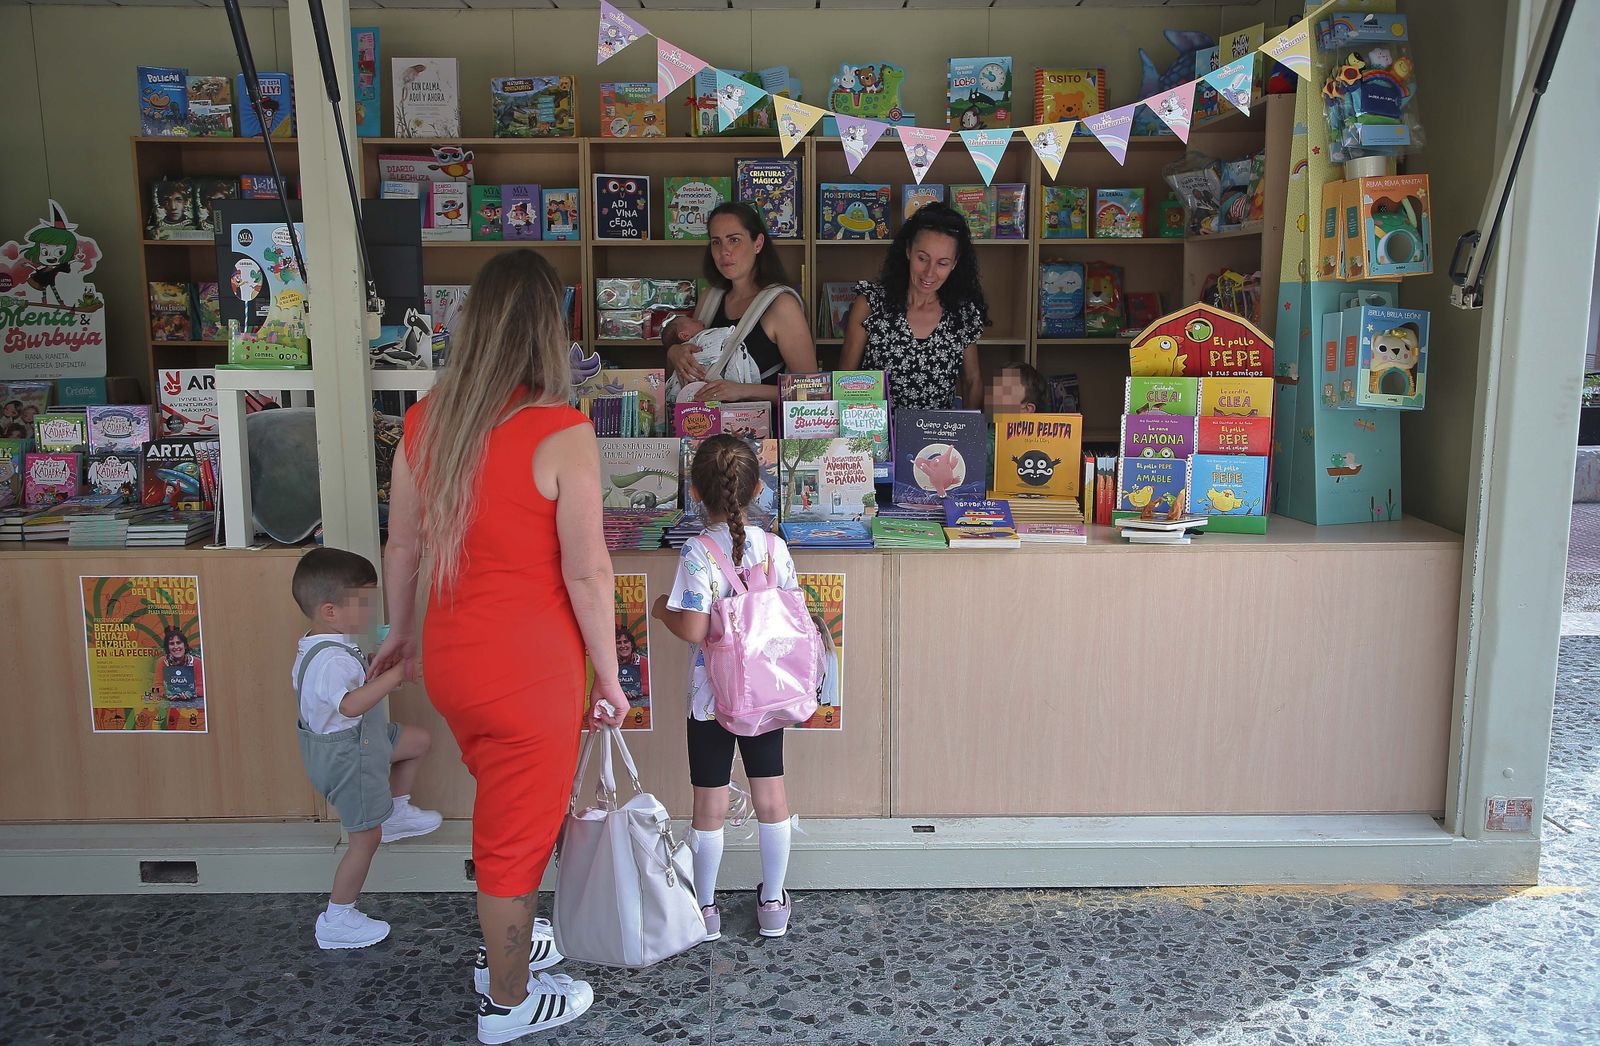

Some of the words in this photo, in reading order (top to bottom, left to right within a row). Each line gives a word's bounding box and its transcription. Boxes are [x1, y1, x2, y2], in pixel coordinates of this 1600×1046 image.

[1272, 33, 1307, 56] Unicornia
[1048, 74, 1081, 84] OSITO
[411, 82, 421, 91] CON
[427, 92, 445, 101] AHORA
[753, 177, 783, 185] MÁGICAS
[611, 200, 628, 209] ADI
[616, 209, 638, 218] VINA
[609, 218, 634, 228] CEDA
[0, 306, 77, 329] Menta
[80, 314, 90, 325] &
[4, 327, 102, 353] Burbuja
[1213, 337, 1225, 346] El
[1228, 338, 1255, 348] pollo
[1209, 350, 1262, 367] PEPE
[1233, 369, 1264, 377] amigos
[1146, 391, 1182, 403] CLEA!
[1218, 396, 1252, 408] CLEA
[789, 404, 829, 418] Menta
[795, 416, 840, 429] Burbuja
[1007, 421, 1034, 440] BICHO
[1037, 421, 1072, 439] PELOTA
[1133, 433, 1185, 445] RAMONA
[1219, 434, 1249, 445] PEPE
[146, 444, 194, 457] ARTA
[1136, 475, 1172, 483] AMABLE
[1212, 472, 1243, 483] PEPE
[150, 577, 197, 588] FERIA
[798, 575, 843, 586] FERIA
[131, 588, 146, 596] DEL
[94, 623, 136, 632] BETZAIDA
[95, 632, 128, 640] URTAZA
[96, 641, 138, 649] ELIZBURO
[96, 649, 107, 657] EN
